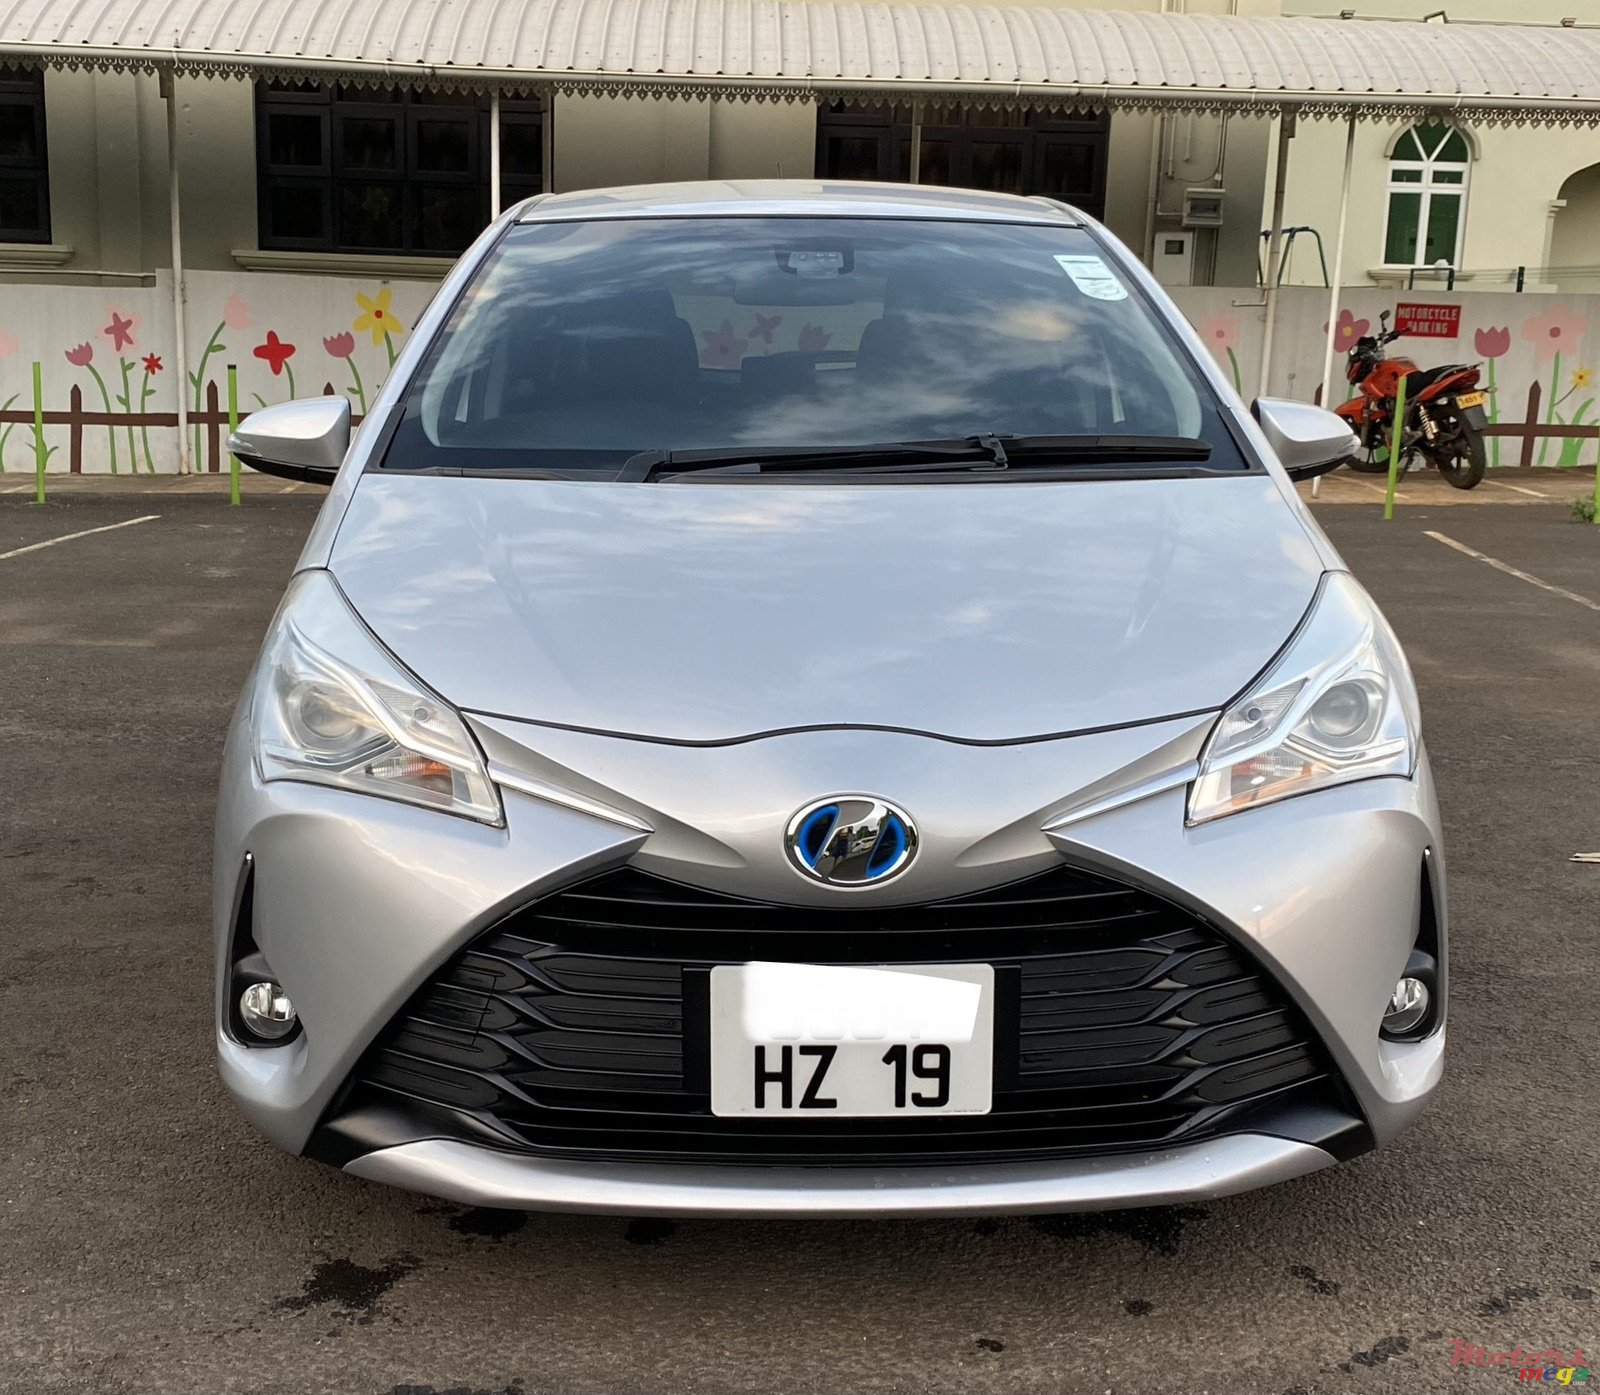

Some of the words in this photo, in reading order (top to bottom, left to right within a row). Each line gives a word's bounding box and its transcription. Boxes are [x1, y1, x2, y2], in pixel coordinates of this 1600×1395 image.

[1398, 306, 1458, 320] MOTORCYCLE
[1407, 320, 1448, 334] PARKING
[754, 1045, 838, 1109] HZ
[882, 1044, 951, 1108] 19
